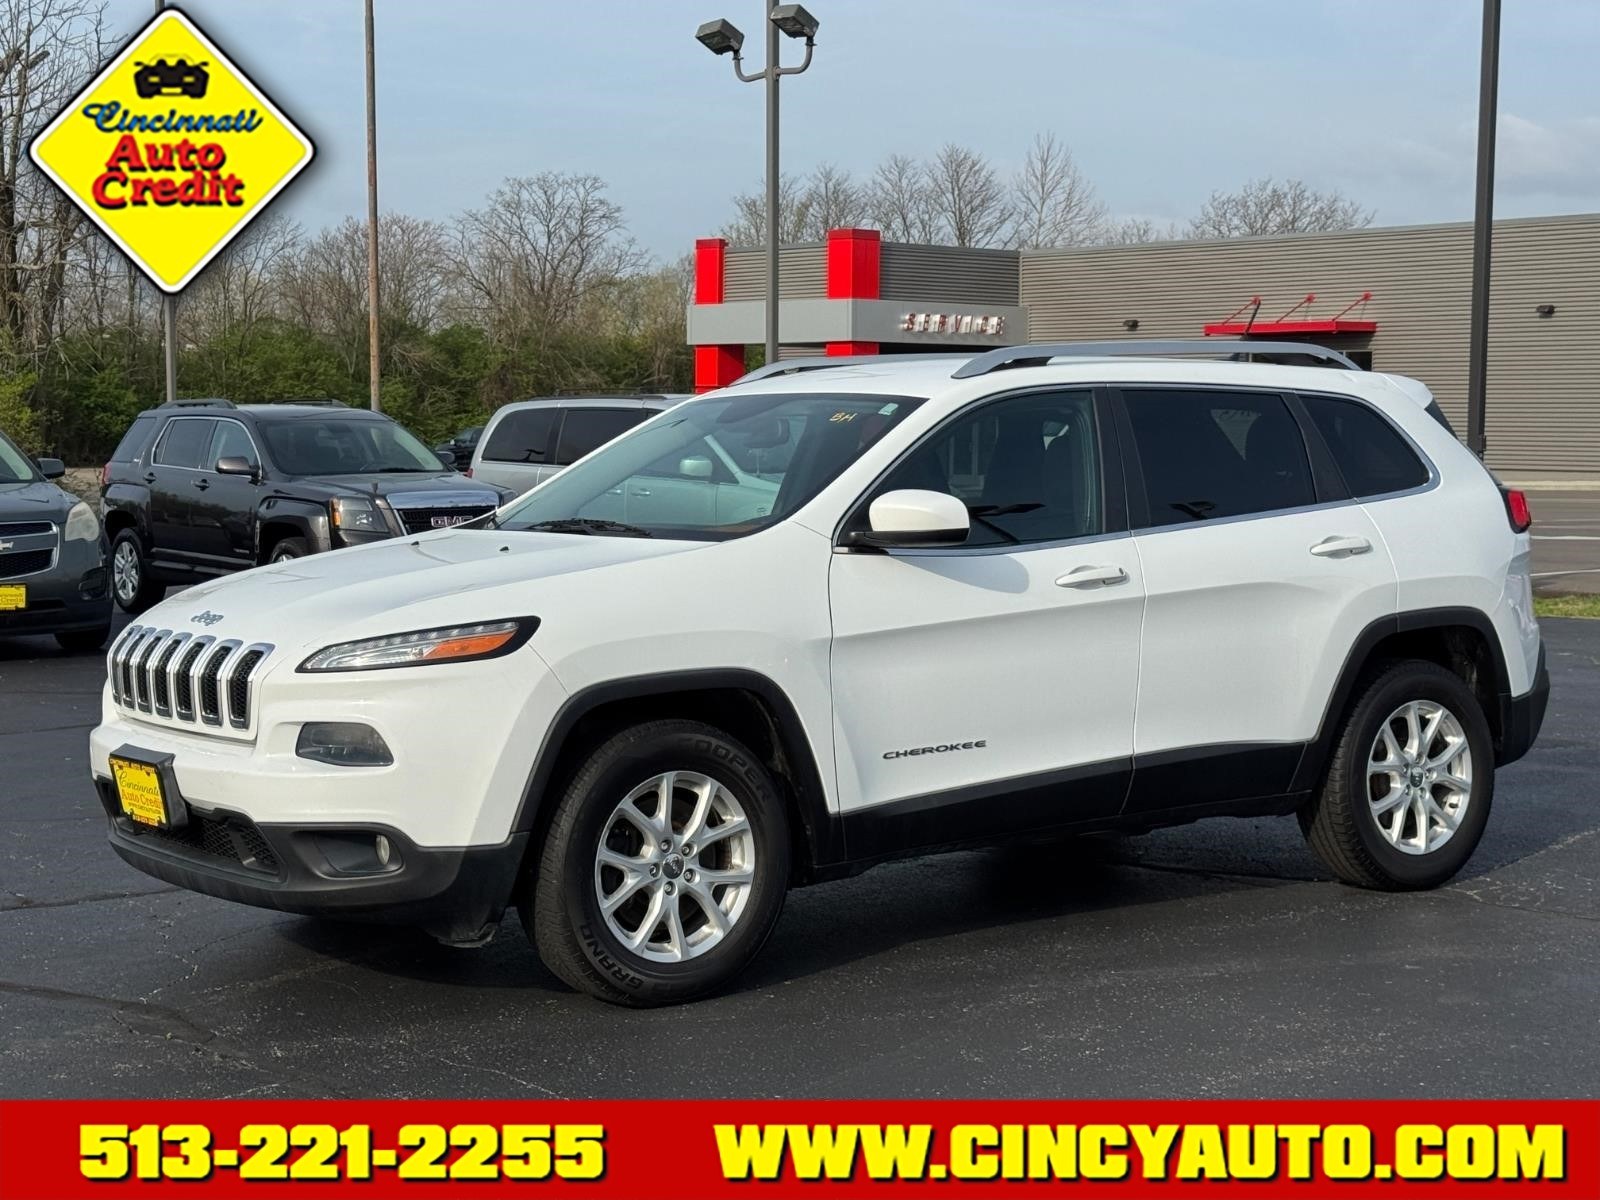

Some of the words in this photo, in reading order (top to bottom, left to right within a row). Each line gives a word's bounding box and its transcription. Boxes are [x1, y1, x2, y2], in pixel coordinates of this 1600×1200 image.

[901, 312, 1005, 336] SERVICE
[431, 515, 474, 528] GMC
[190, 610, 224, 627] Jeep
[882, 739, 987, 760] CHEROKEE
